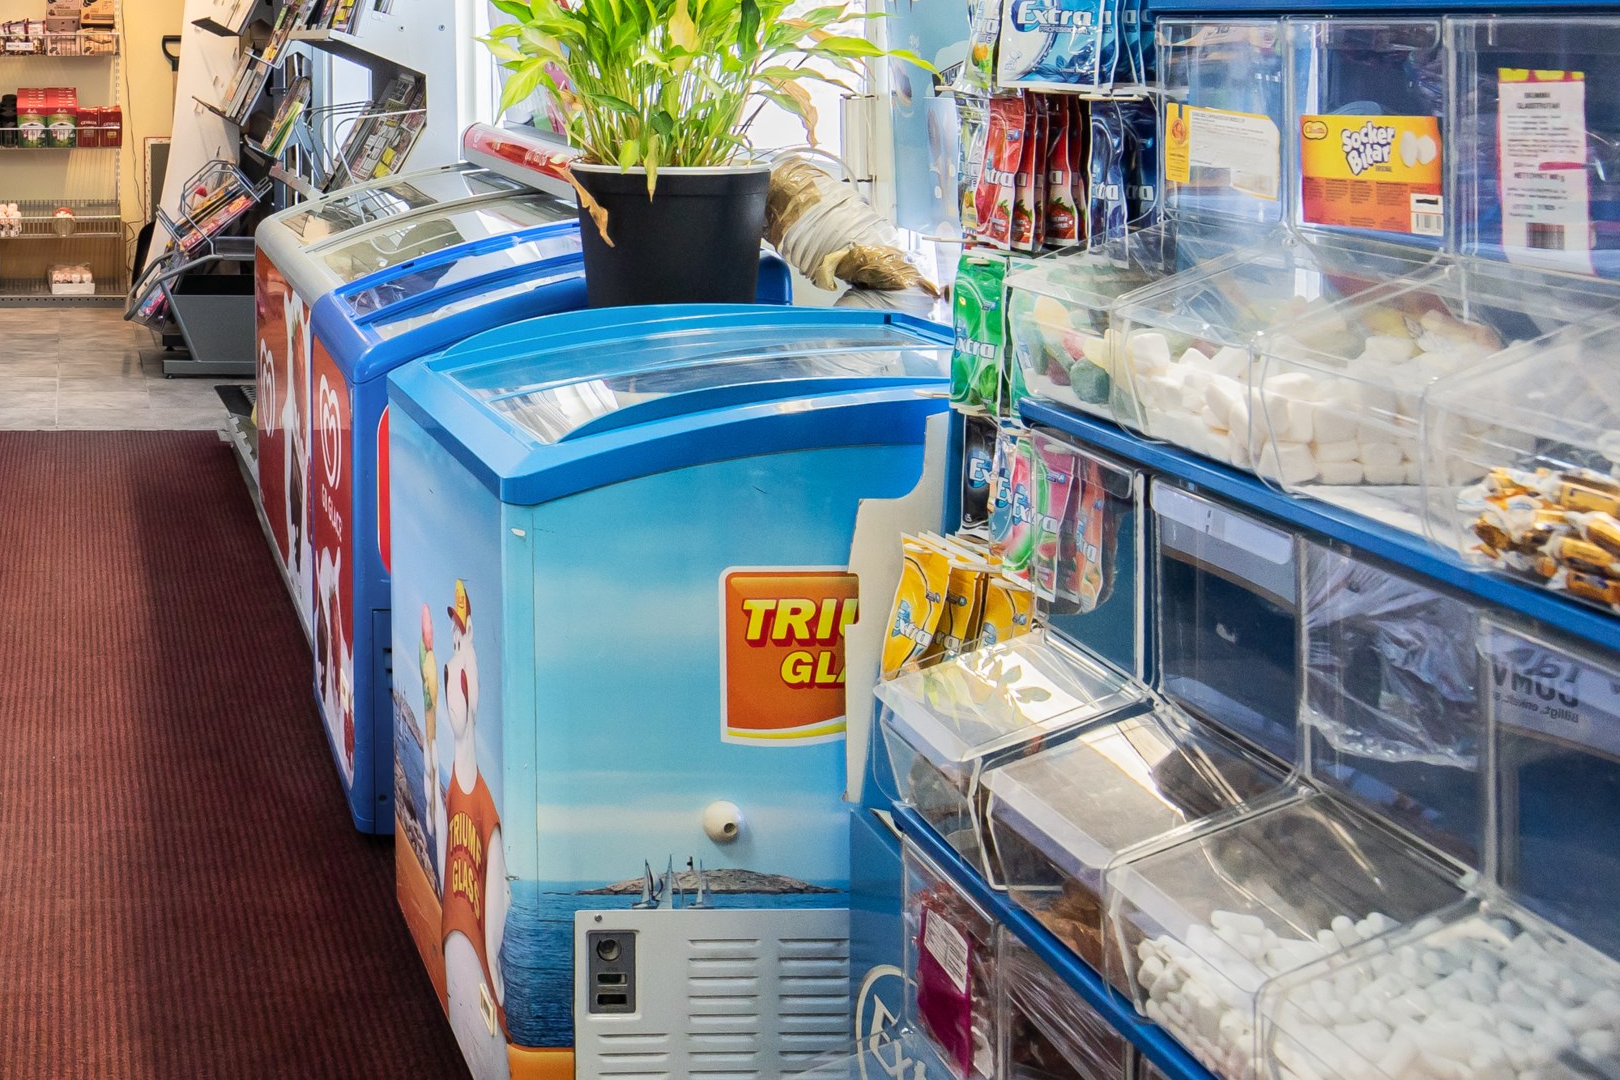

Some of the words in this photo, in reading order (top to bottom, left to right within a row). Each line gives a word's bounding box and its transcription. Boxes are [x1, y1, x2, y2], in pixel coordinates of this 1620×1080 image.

[1017, 0, 1093, 27] Extra
[1341, 121, 1397, 153] Socker
[1346, 145, 1392, 176] Bitar
[449, 811, 481, 871] TRIUMF
[451, 864, 481, 918] GLASS
